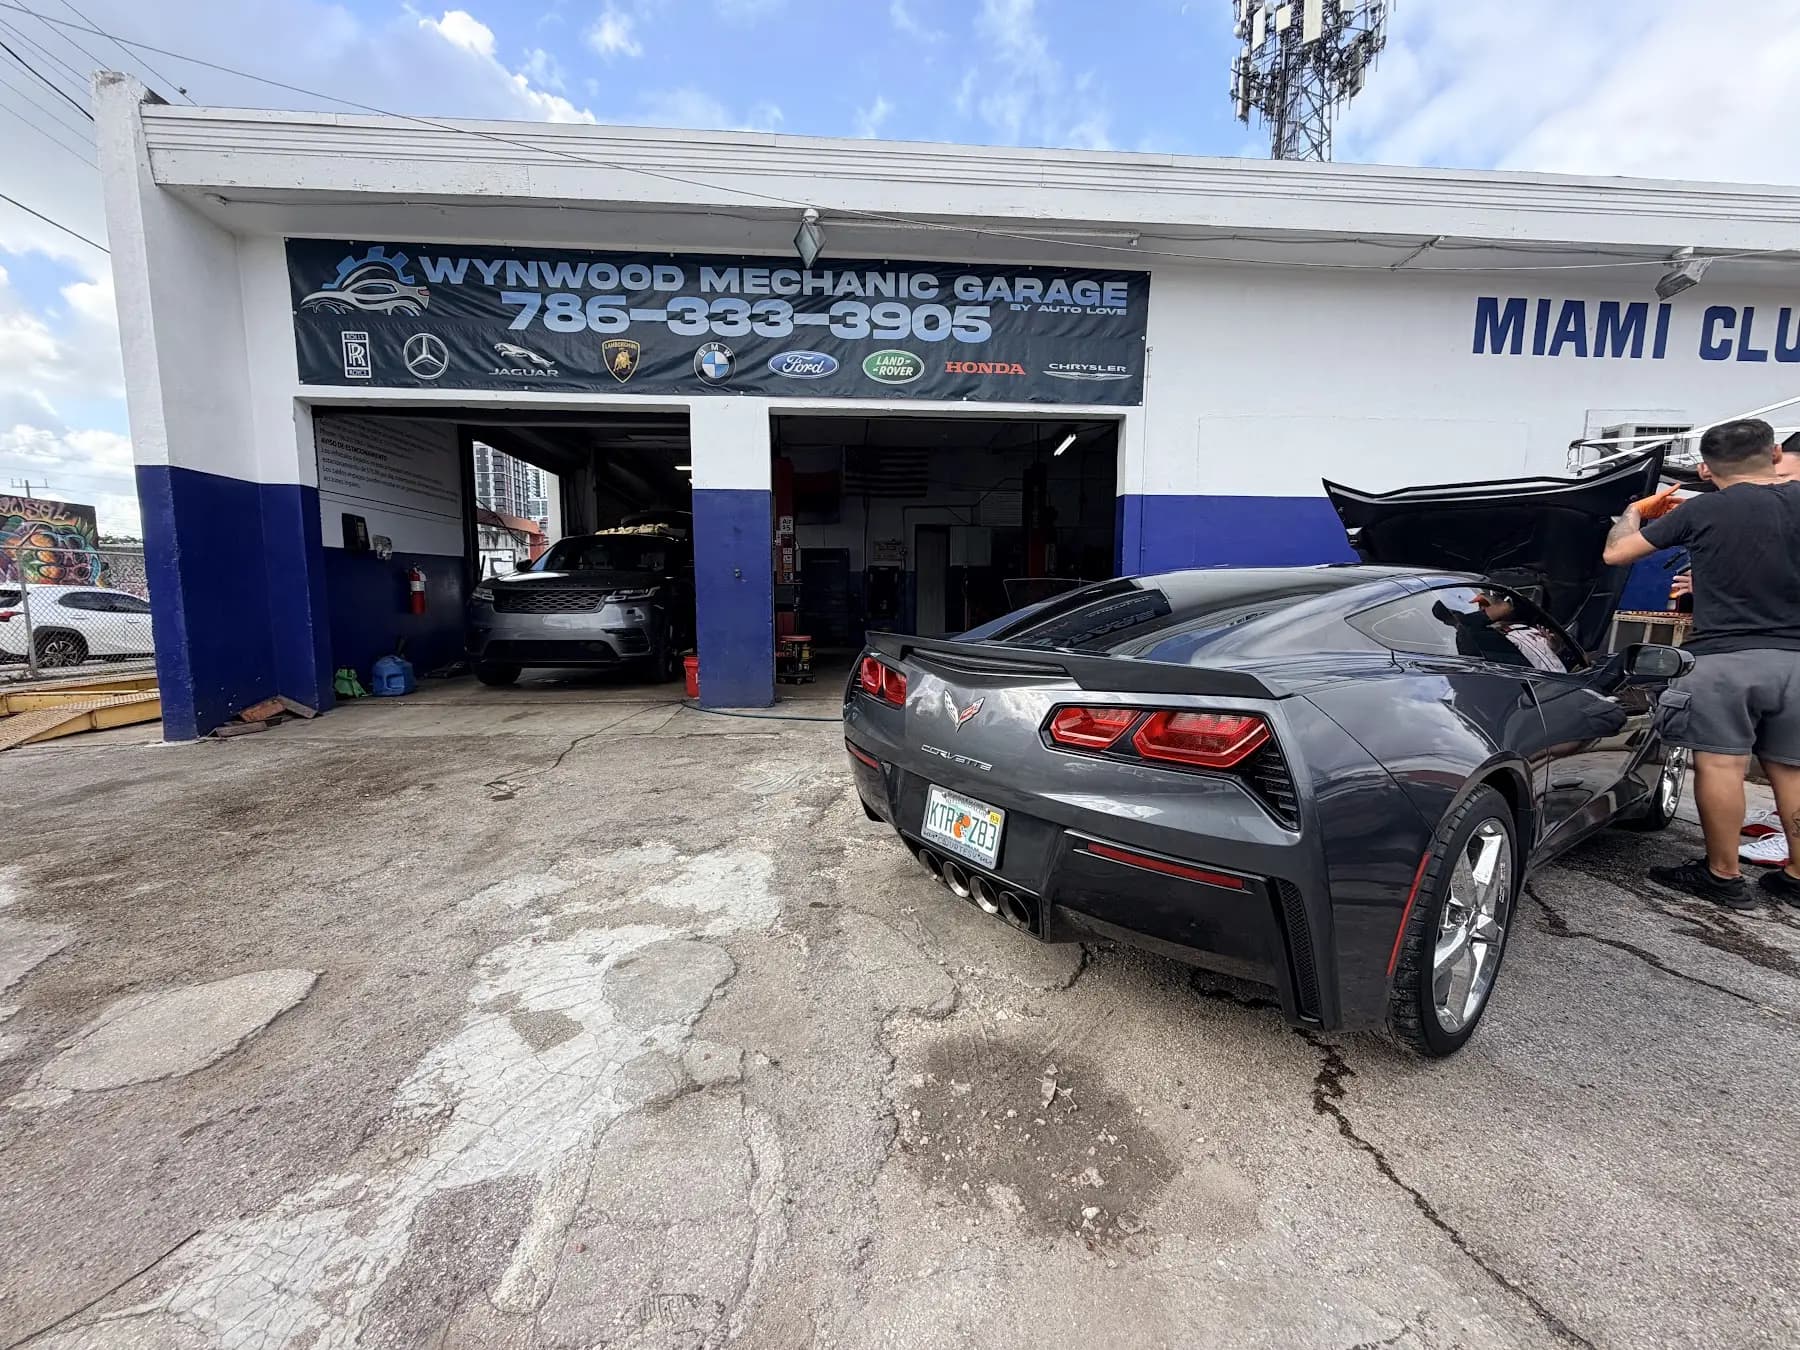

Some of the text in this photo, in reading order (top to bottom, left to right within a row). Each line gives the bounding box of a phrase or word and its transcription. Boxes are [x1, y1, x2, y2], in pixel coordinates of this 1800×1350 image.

[418, 256, 1128, 307] WYNWOOD MECHANIC GARAGE
[501, 291, 992, 344] 786-333-3905
[1010, 303, 1127, 316] BY AUTO LOVE
[1472, 296, 1800, 363] MIAMI CLU
[488, 367, 560, 378] JAGUAR
[782, 354, 825, 374] Ford
[945, 360, 1027, 376] HONDA
[1048, 362, 1127, 373] CHRYSLER
[921, 743, 993, 772] CORVETTE
[929, 800, 955, 834] KTR
